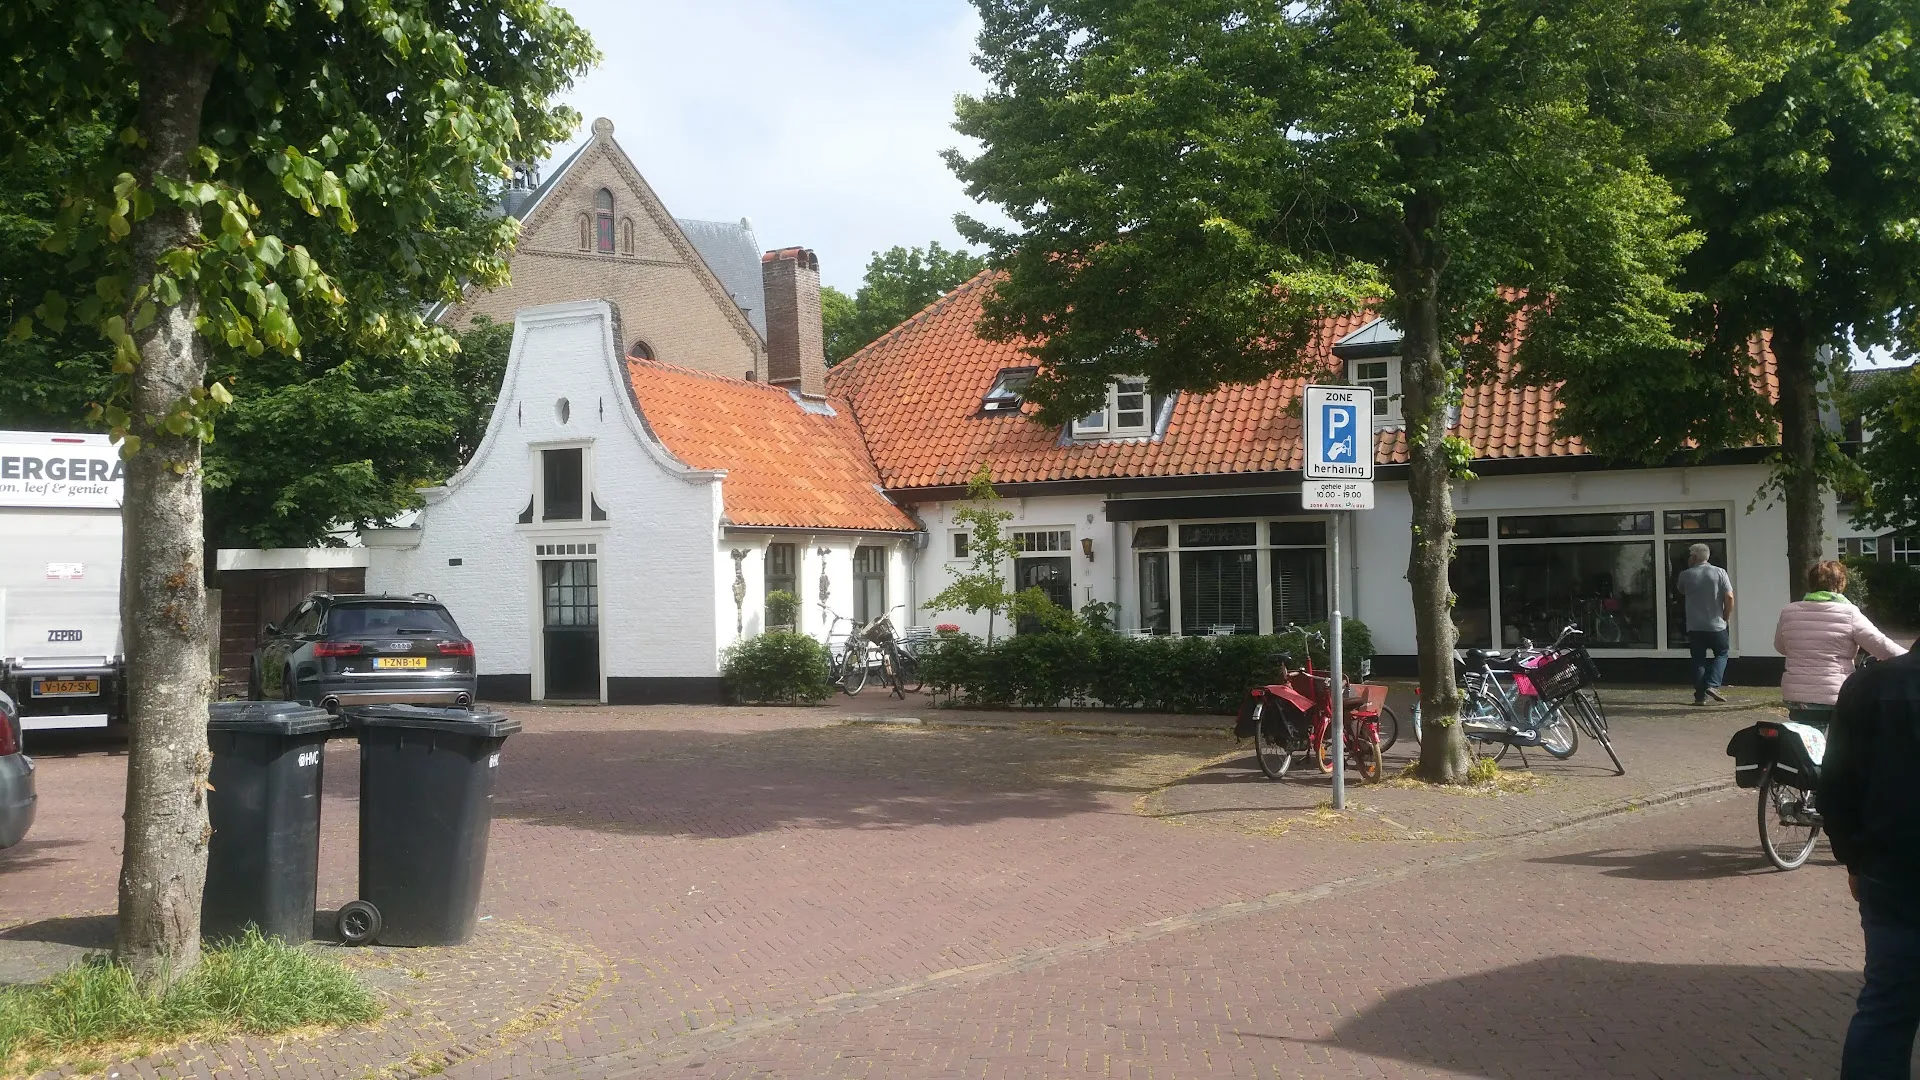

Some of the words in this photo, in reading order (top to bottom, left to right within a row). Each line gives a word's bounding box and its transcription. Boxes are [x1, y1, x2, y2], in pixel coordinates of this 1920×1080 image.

[1326, 393, 1353, 402] ZONE
[1329, 408, 1350, 439] P
[1314, 464, 1364, 477] herhaling
[24, 482, 50, 496] leef
[52, 485, 66, 494] &
[68, 484, 108, 496] geniet
[384, 658, 421, 667] 1-ZNB-14
[45, 682, 92, 692] V-167-SK
